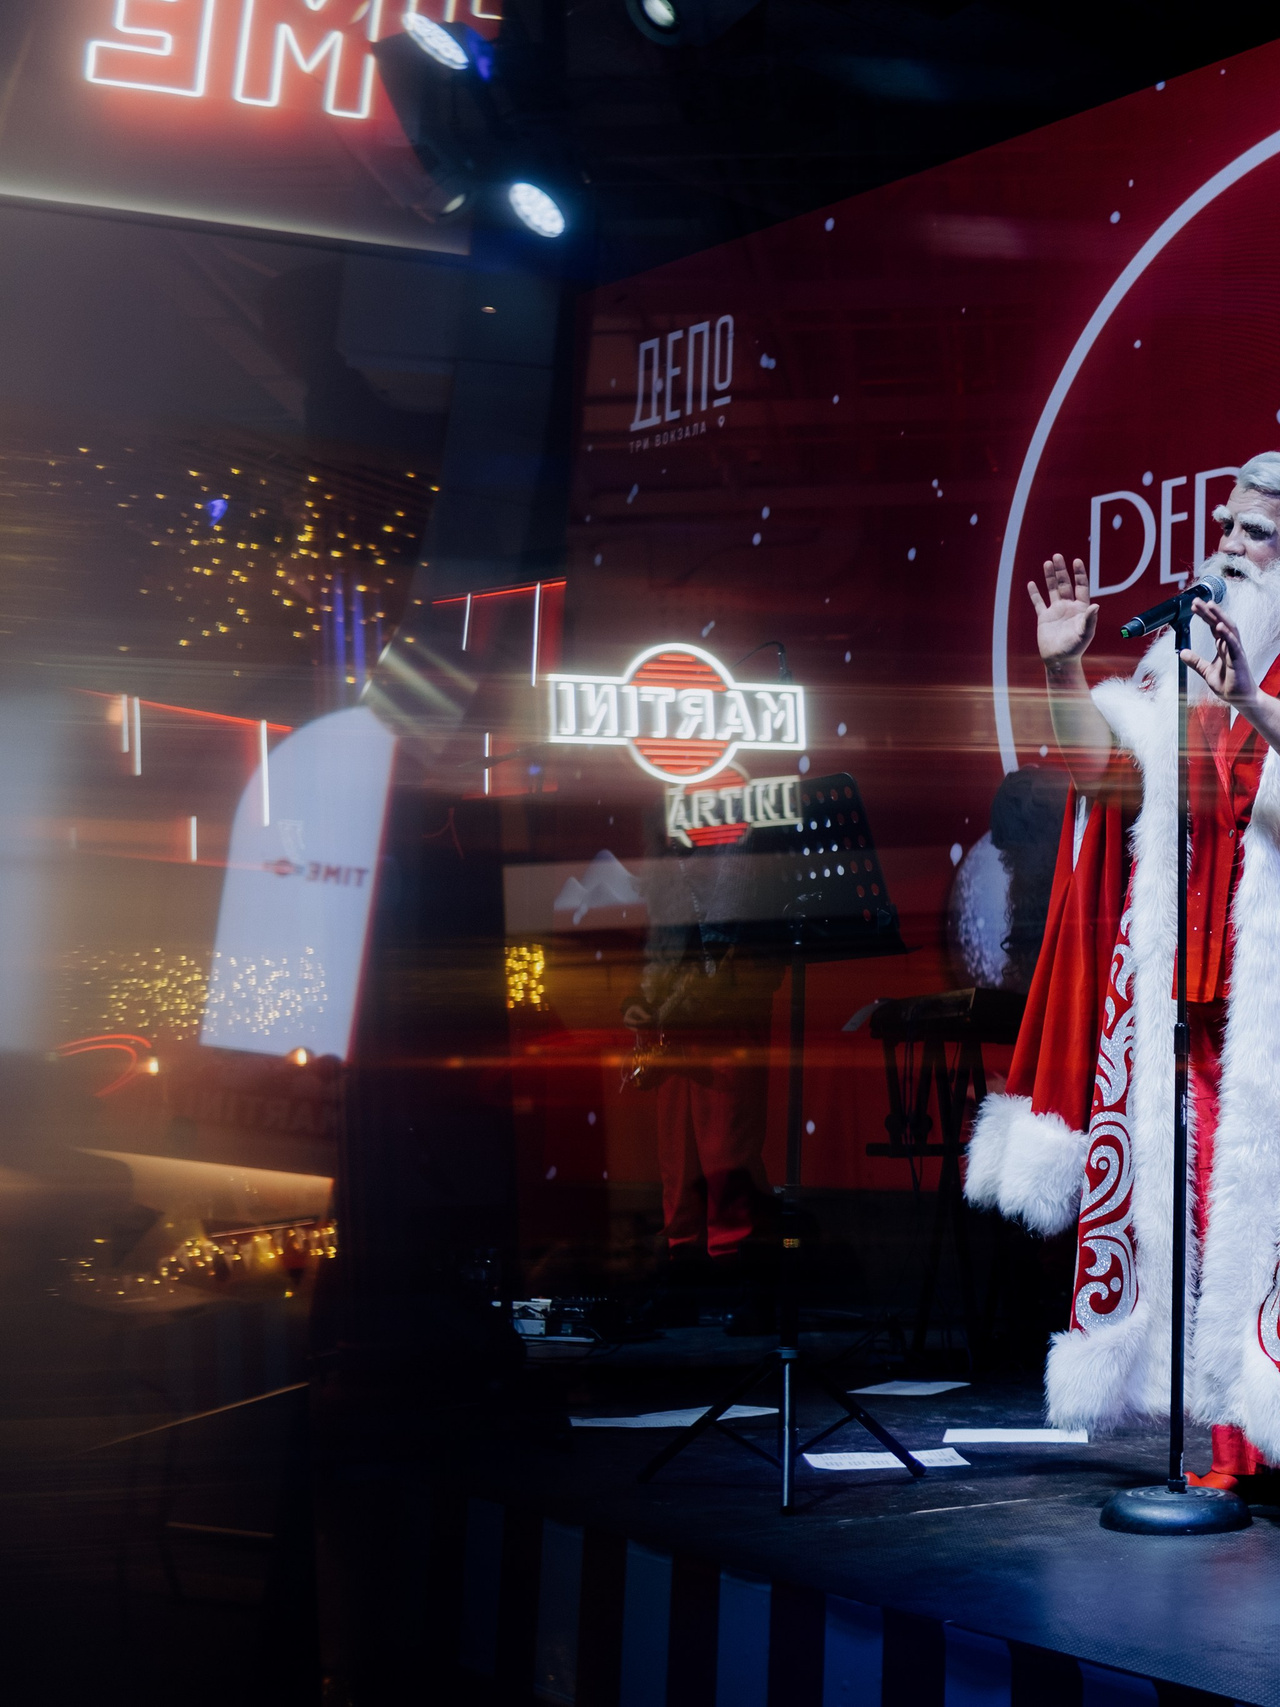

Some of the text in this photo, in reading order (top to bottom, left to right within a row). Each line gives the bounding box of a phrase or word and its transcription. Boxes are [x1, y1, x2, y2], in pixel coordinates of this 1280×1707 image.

[629, 314, 734, 432] ДЕПО
[629, 421, 707, 453] ТРИ ВОКЗАЛА
